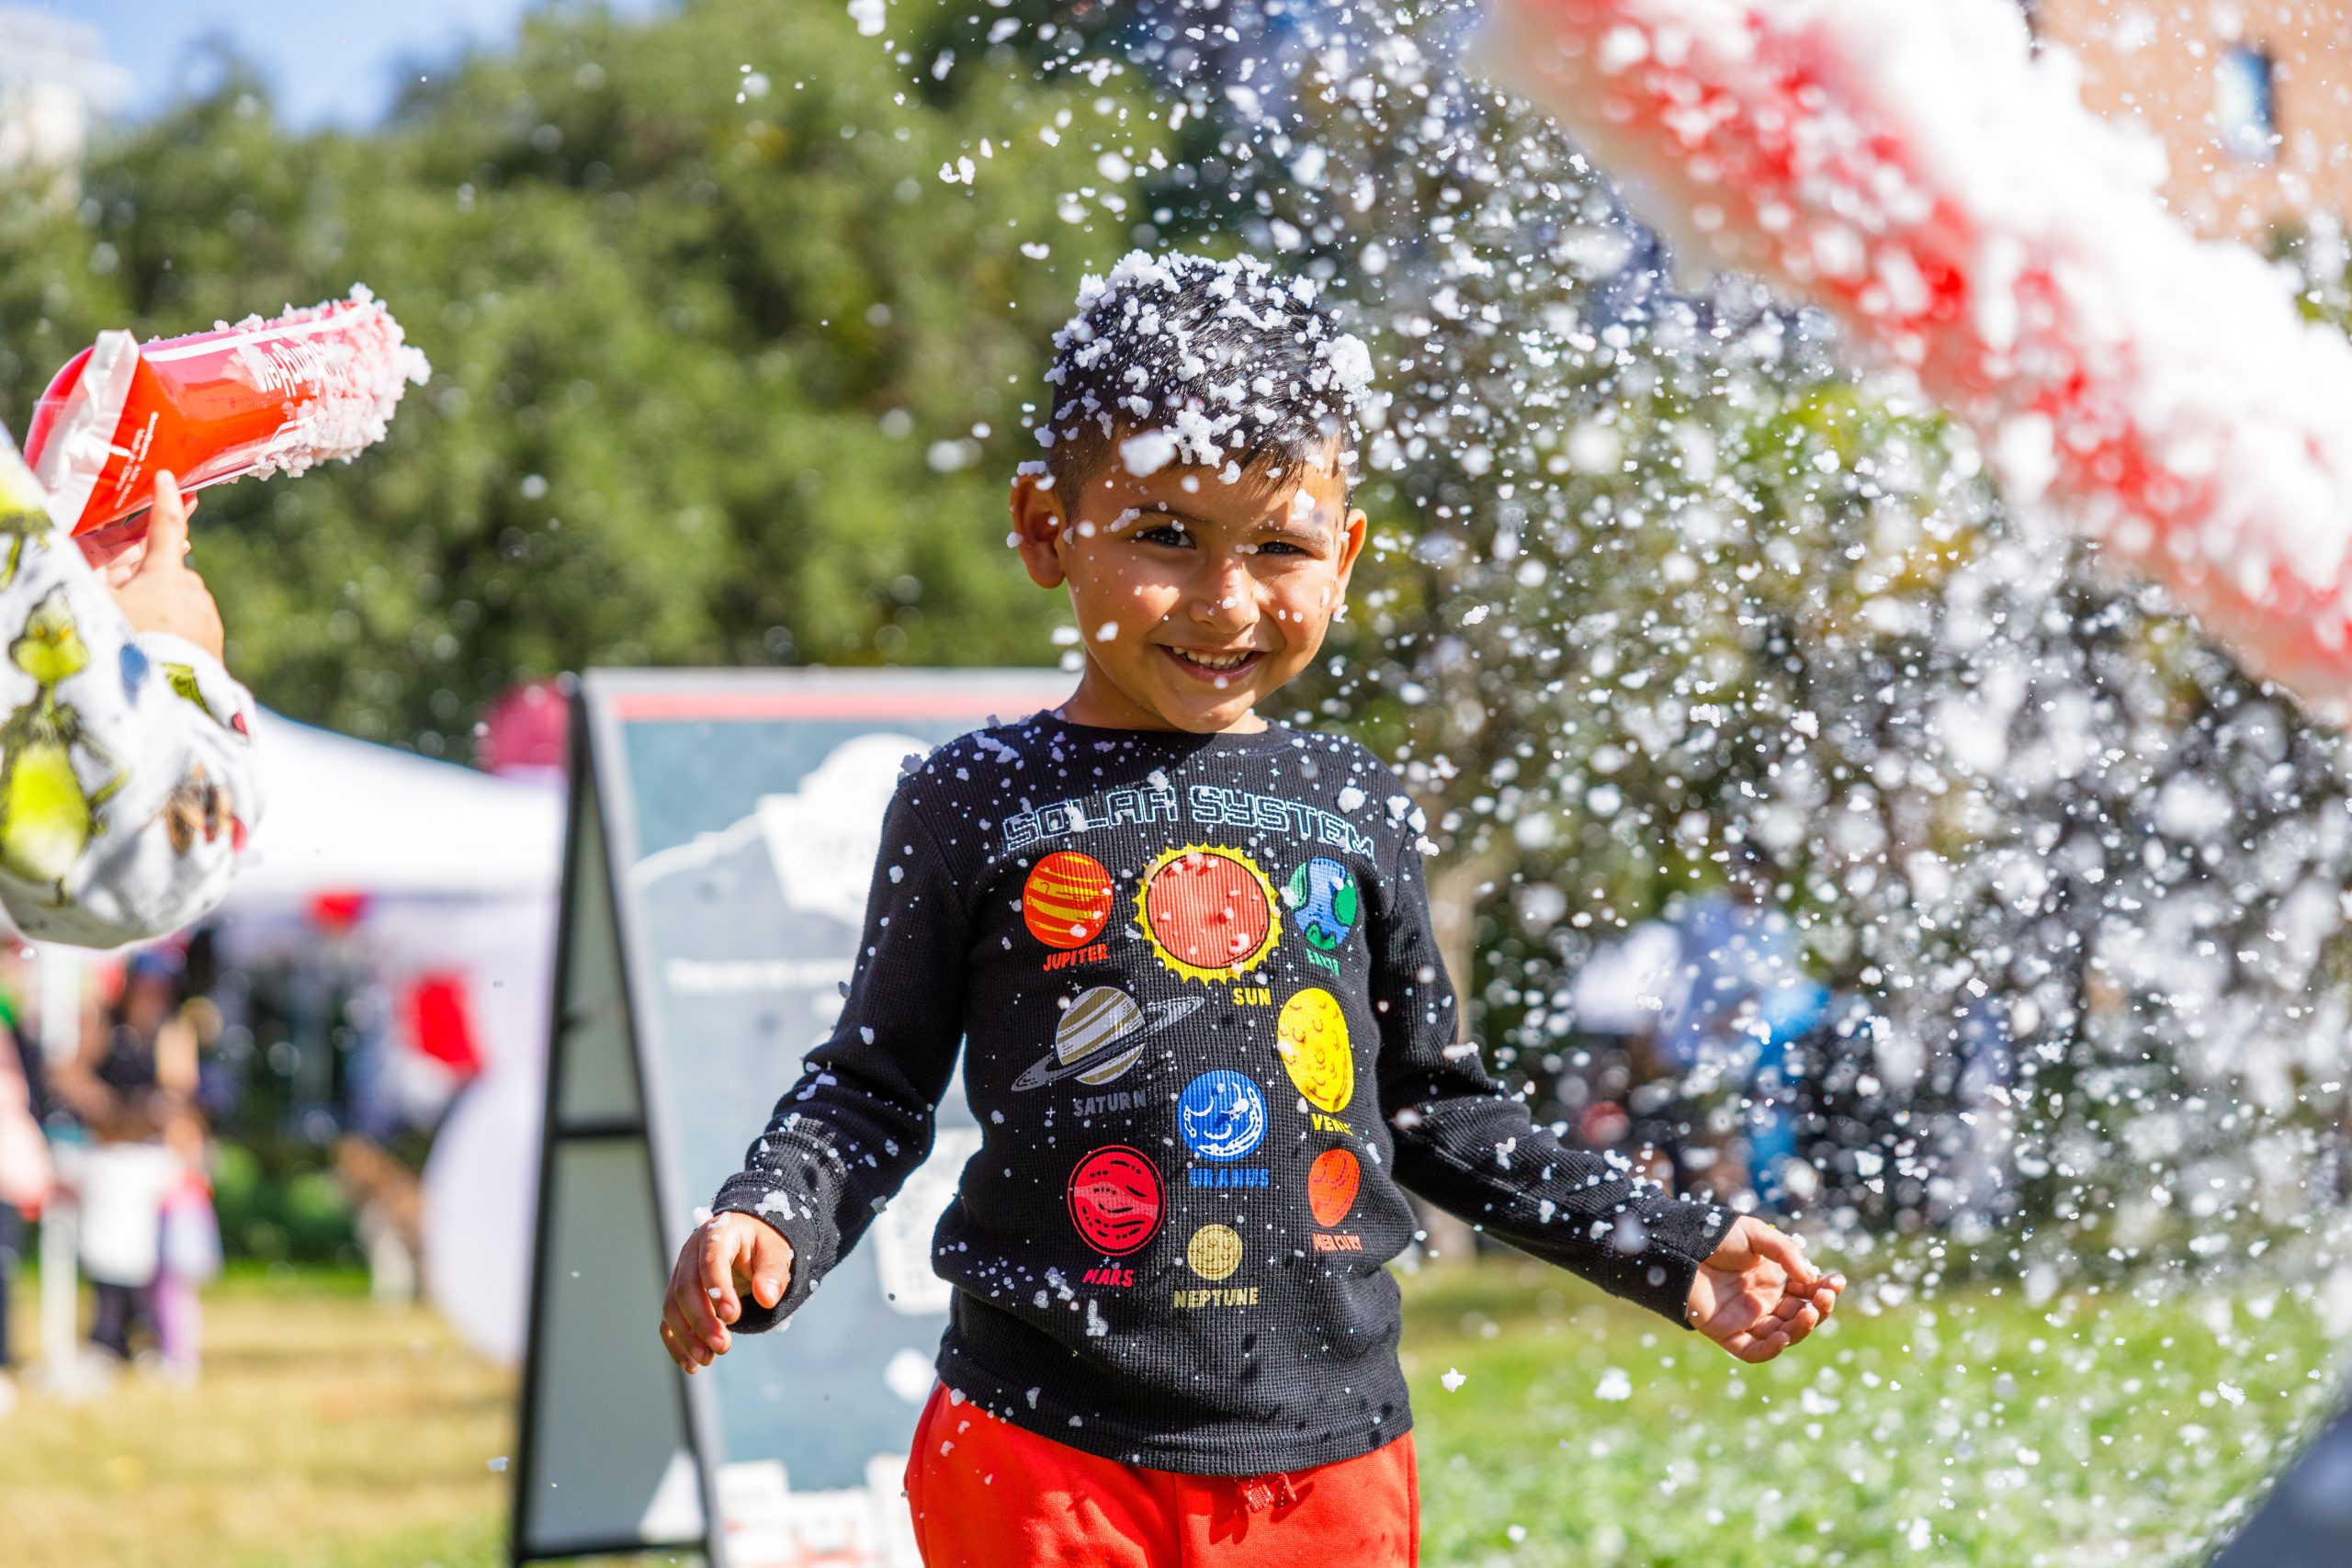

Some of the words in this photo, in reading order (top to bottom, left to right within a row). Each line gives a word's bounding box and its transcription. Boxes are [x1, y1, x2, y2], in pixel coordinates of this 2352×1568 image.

[1001, 784, 1179, 852] SOLAR
[1189, 785, 1377, 869] SYSTEM
[1043, 943, 1109, 971] JUPITER
[1233, 987, 1272, 1006] SUN
[1073, 1089, 1147, 1117] SATURN
[1190, 1168, 1269, 1188] URANUS
[1312, 1233, 1363, 1250] MERCURY
[1082, 1269, 1134, 1287] MARS
[1173, 1287, 1259, 1308] NEPTUNE
